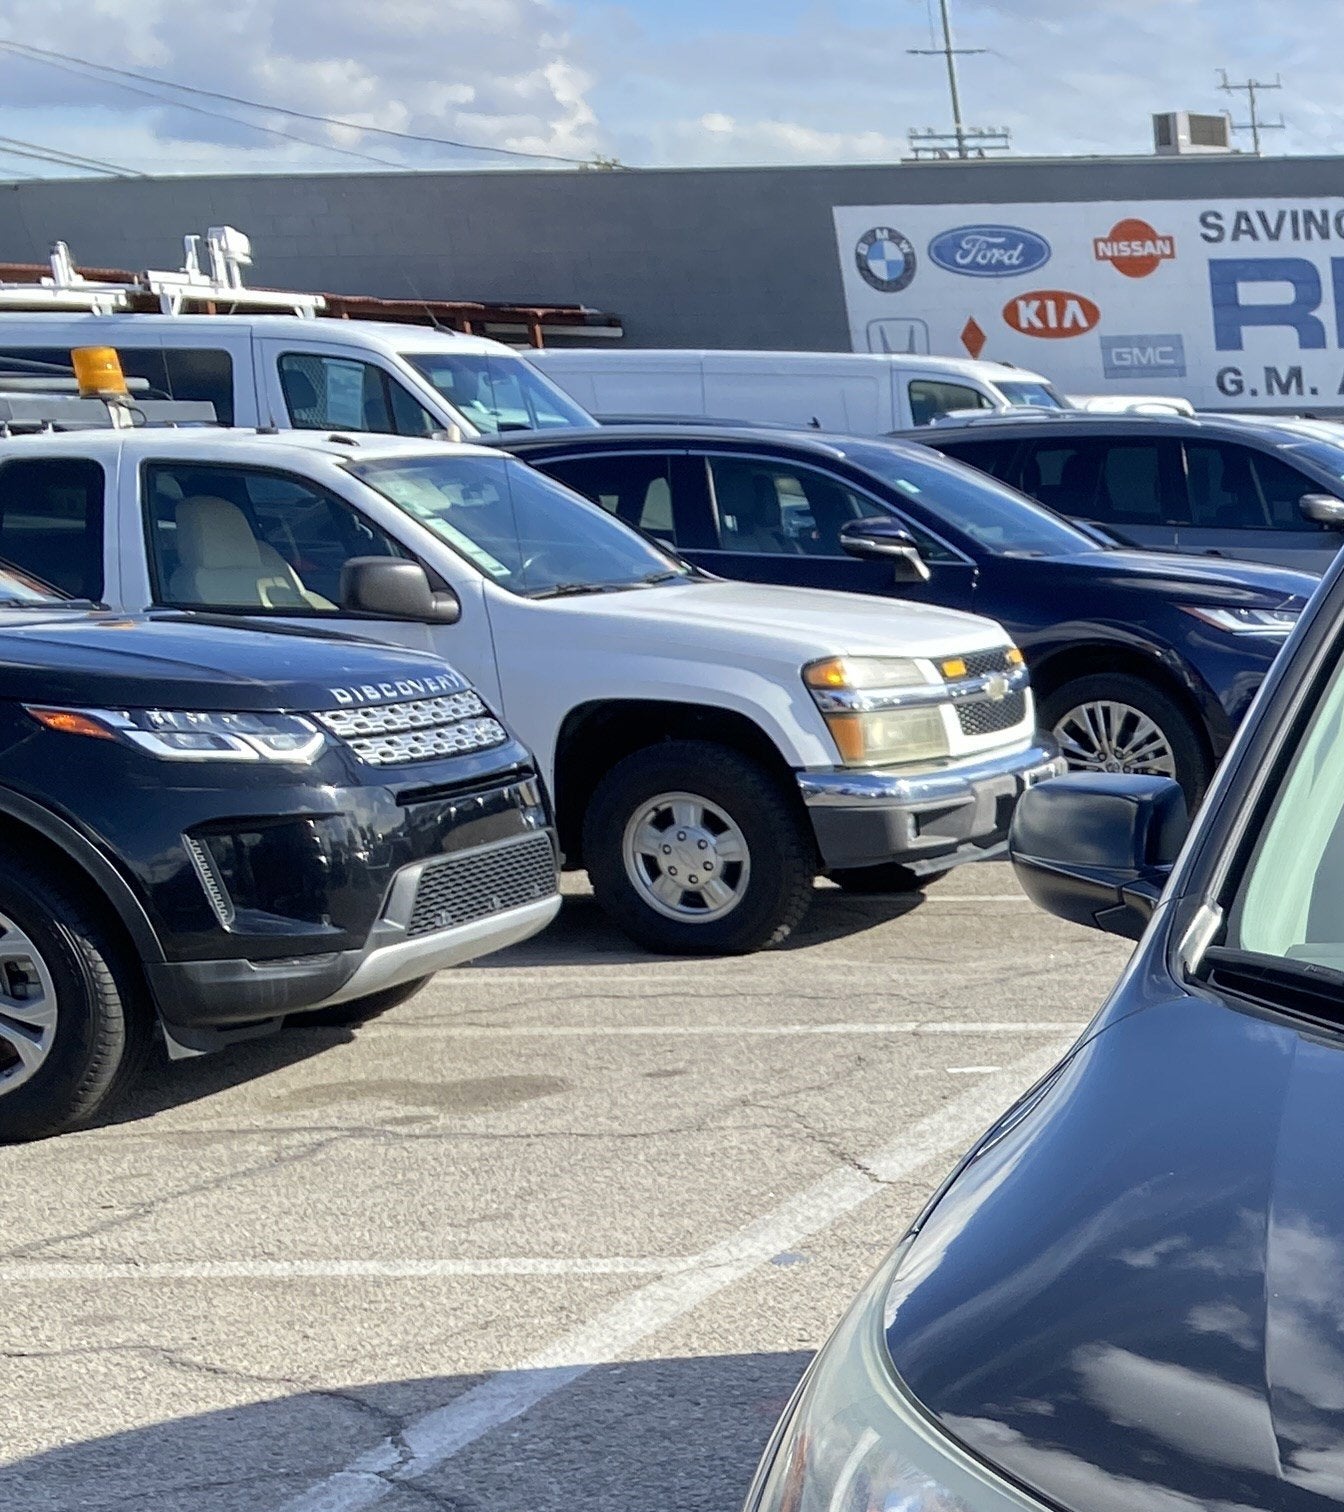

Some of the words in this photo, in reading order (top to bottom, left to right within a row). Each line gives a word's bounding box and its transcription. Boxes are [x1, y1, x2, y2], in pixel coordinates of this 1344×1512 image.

[955, 234, 1025, 266] Ford
[1097, 239, 1172, 258] NISSAN
[1016, 299, 1090, 329] KIA
[1111, 346, 1176, 366] GMC
[1215, 364, 1320, 397] G.M.
[330, 672, 461, 705] DISCOVERY
